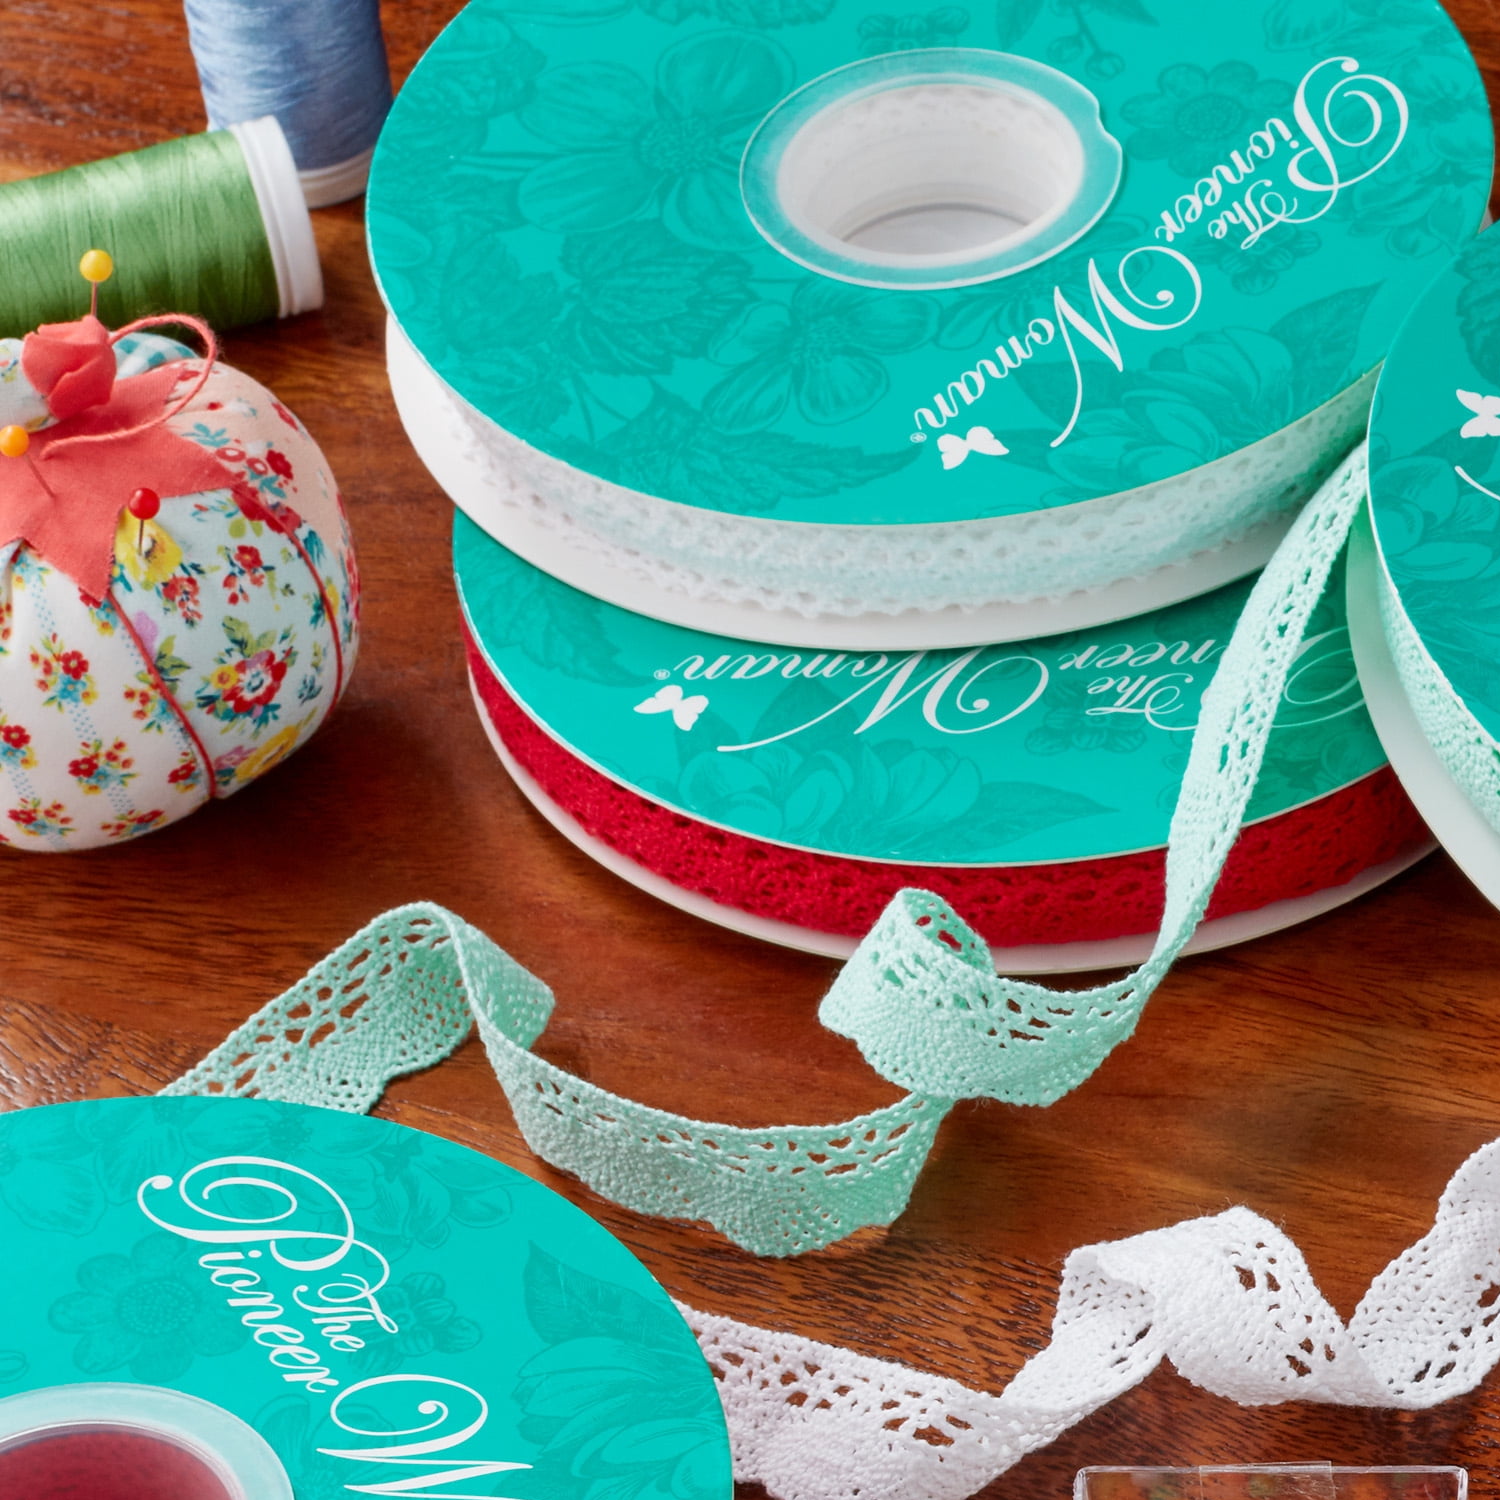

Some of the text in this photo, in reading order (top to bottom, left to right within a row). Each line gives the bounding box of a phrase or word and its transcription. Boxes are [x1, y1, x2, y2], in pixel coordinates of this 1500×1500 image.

[1156, 56, 1409, 241] Pioneer
[1207, 178, 1298, 250] The
[1085, 672, 1193, 716] The
[137, 1156, 390, 1393] Pioneer
[293, 1273, 398, 1353] The
